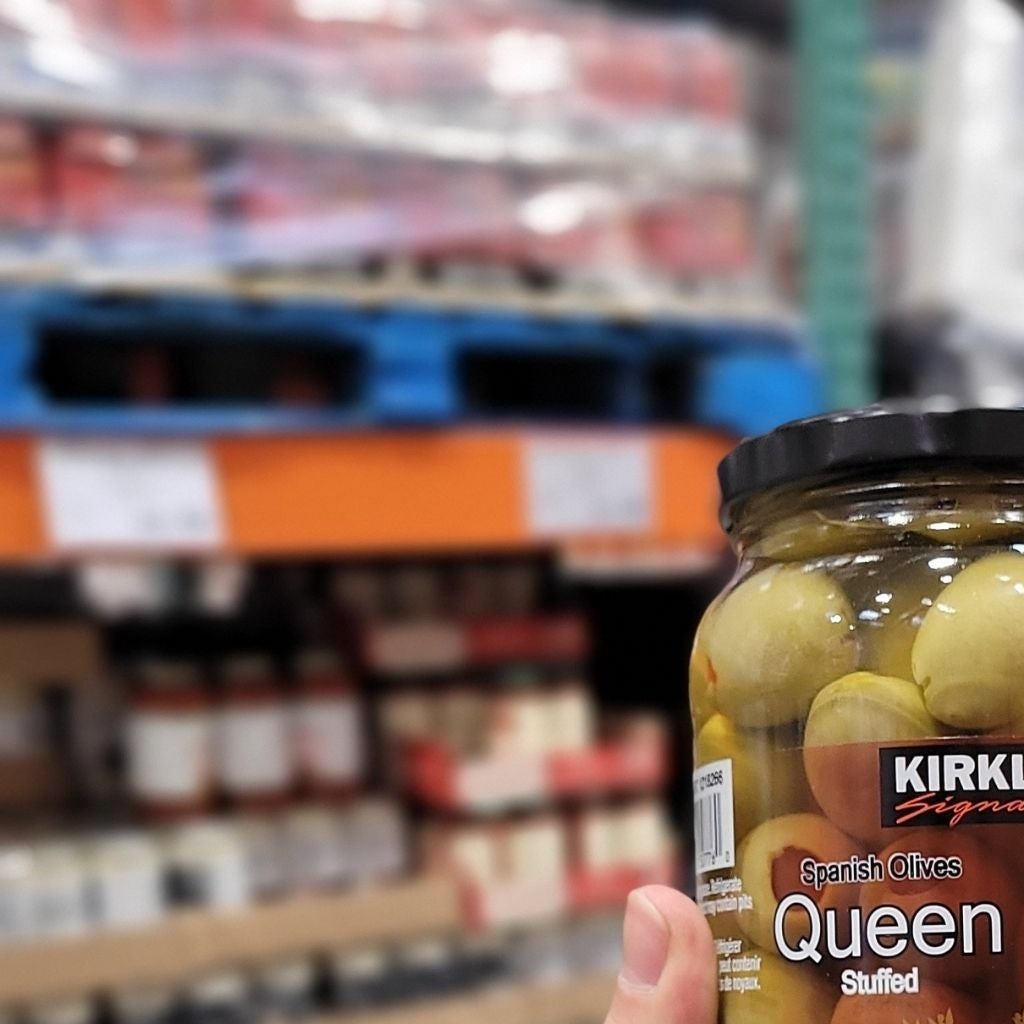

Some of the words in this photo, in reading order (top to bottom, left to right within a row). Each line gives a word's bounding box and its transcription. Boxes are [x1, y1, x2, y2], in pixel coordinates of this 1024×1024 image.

[800, 855, 883, 888] Spanish
[889, 851, 963, 880] Olives
[774, 892, 1002, 964] Queen
[841, 967, 918, 997] Stuffed
